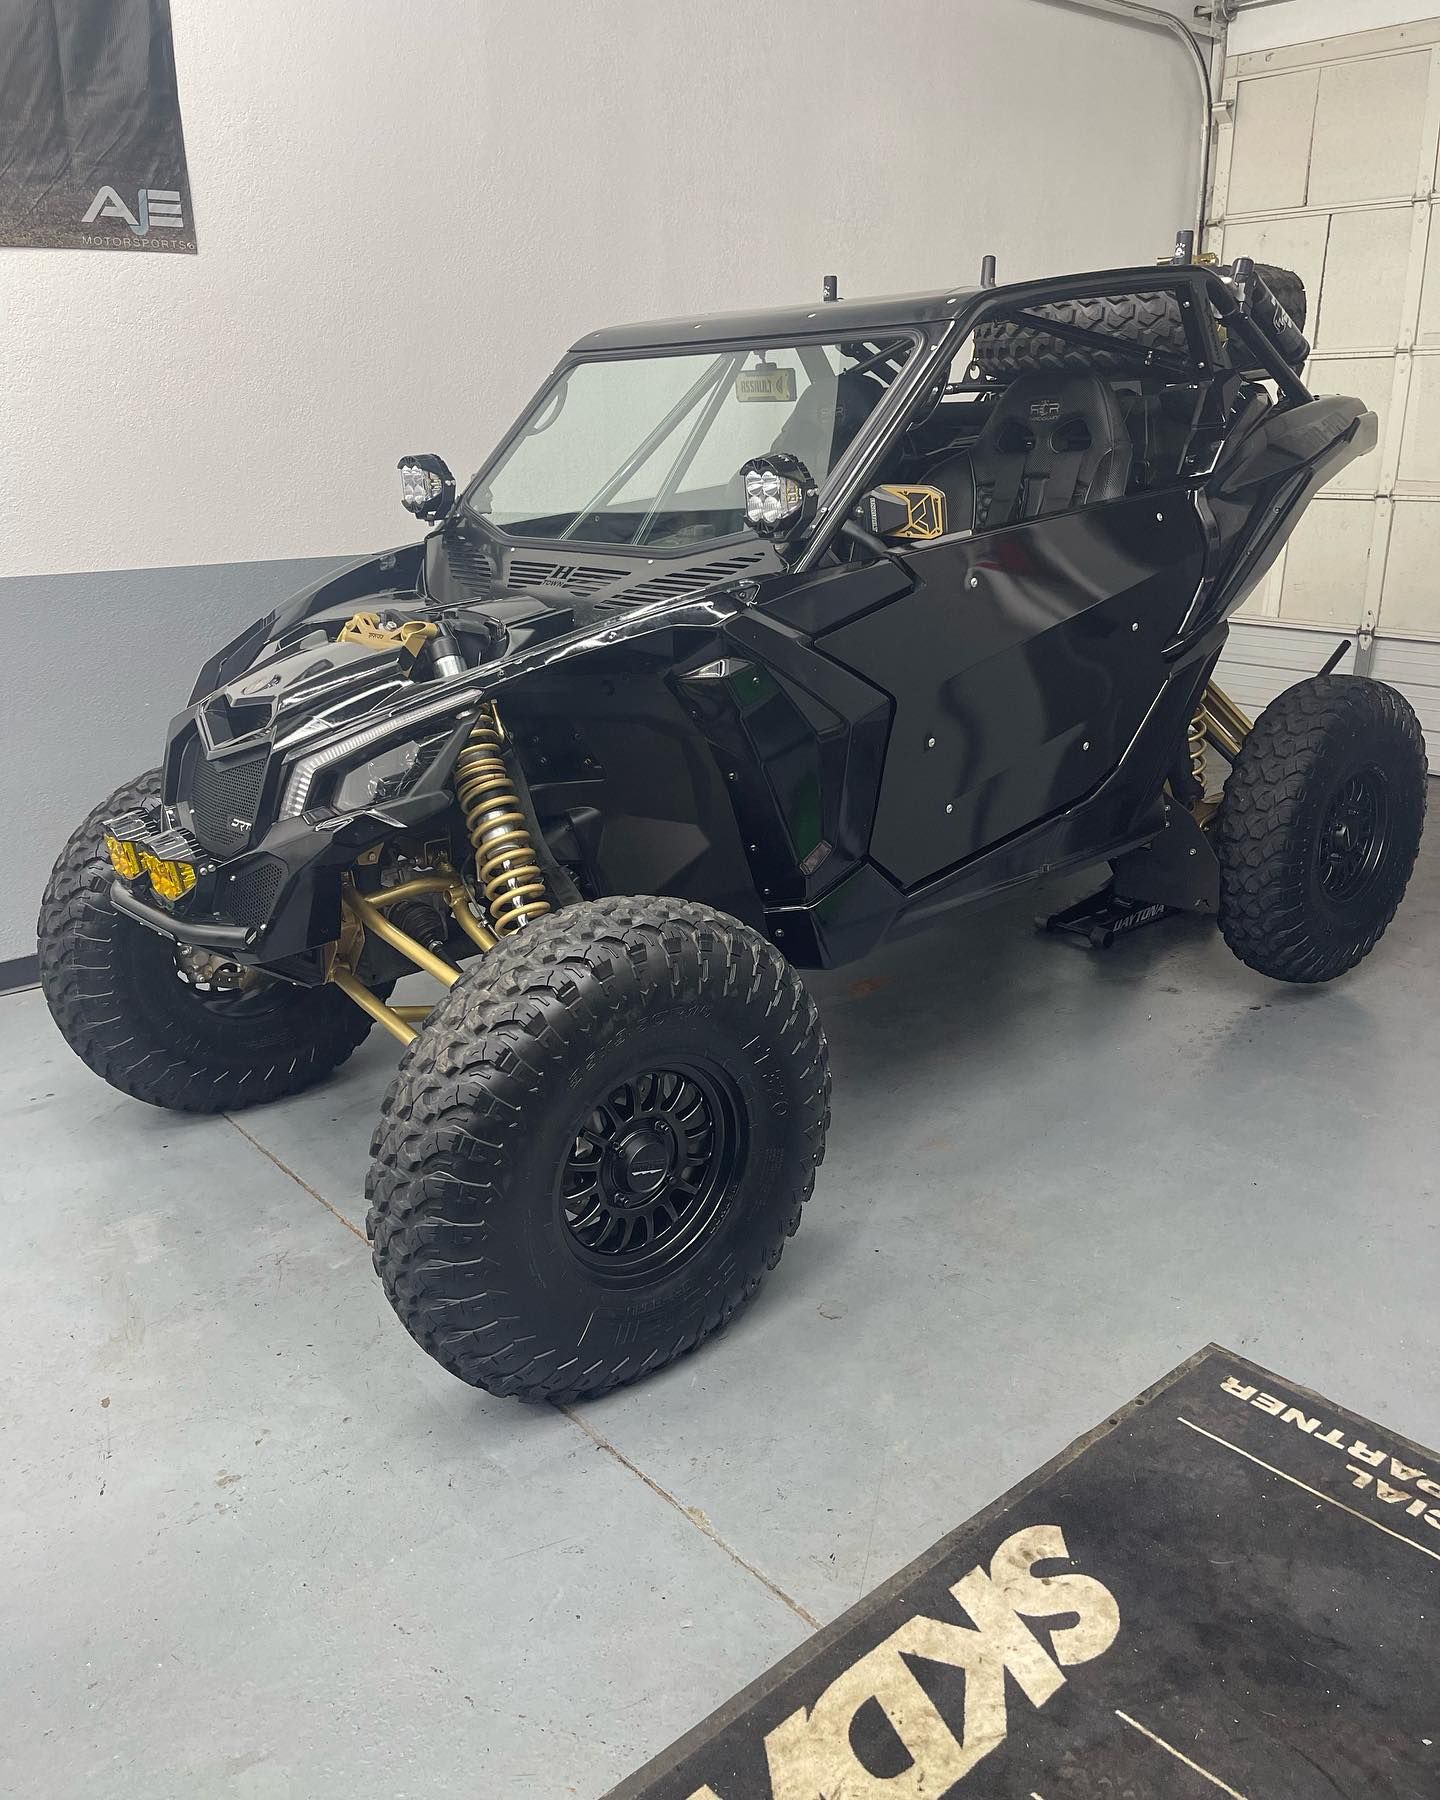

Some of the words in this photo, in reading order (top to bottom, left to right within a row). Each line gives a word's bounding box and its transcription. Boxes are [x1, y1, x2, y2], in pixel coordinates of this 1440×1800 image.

[81, 185, 184, 236] AJE
[82, 236, 187, 249] MOTORSPORTS
[740, 375, 773, 393] ASSAULT
[551, 565, 577, 580] H
[541, 579, 564, 588] TOWN
[1112, 903, 1166, 932] DAYTONA
[1219, 1375, 1440, 1499] PARTNER
